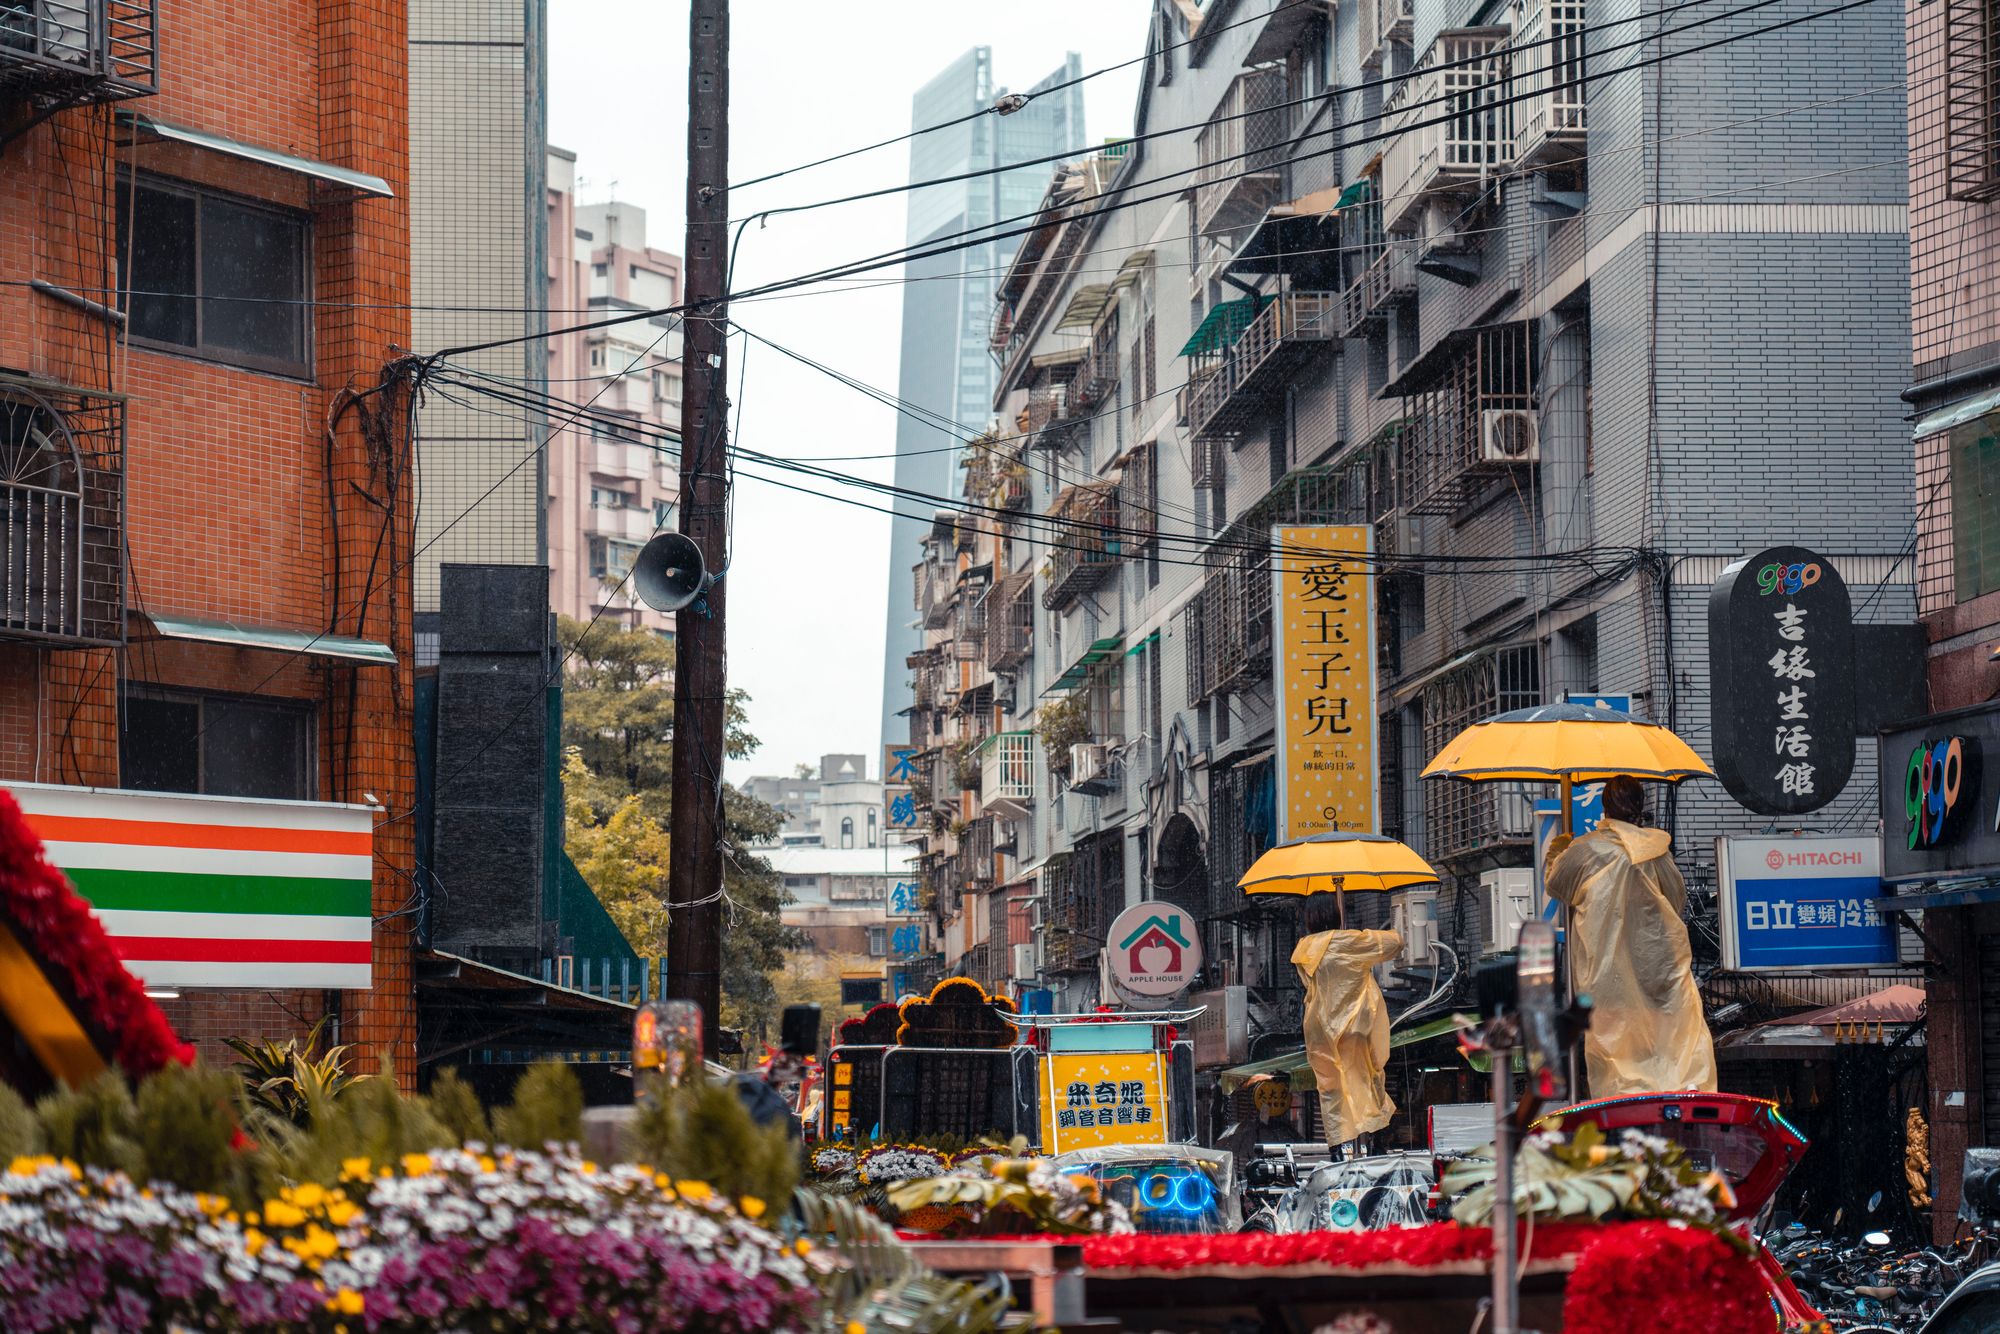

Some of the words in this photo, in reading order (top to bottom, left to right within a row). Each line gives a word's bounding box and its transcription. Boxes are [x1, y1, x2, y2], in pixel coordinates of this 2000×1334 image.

[1756, 562, 1822, 596] gigo
[1300, 562, 1352, 737] 愛玉子兒
[1768, 603, 1816, 796] 吉緣生活館
[1303, 761, 1356, 771] 傳統的日常
[1905, 736, 1962, 850] gigo
[1787, 851, 1862, 867] HITACHI
[1746, 899, 1887, 930] 日立變頻冷氣
[1067, 1081, 1145, 1106] 米奇妮
[1058, 1107, 1152, 1128] 鋼管音響車
